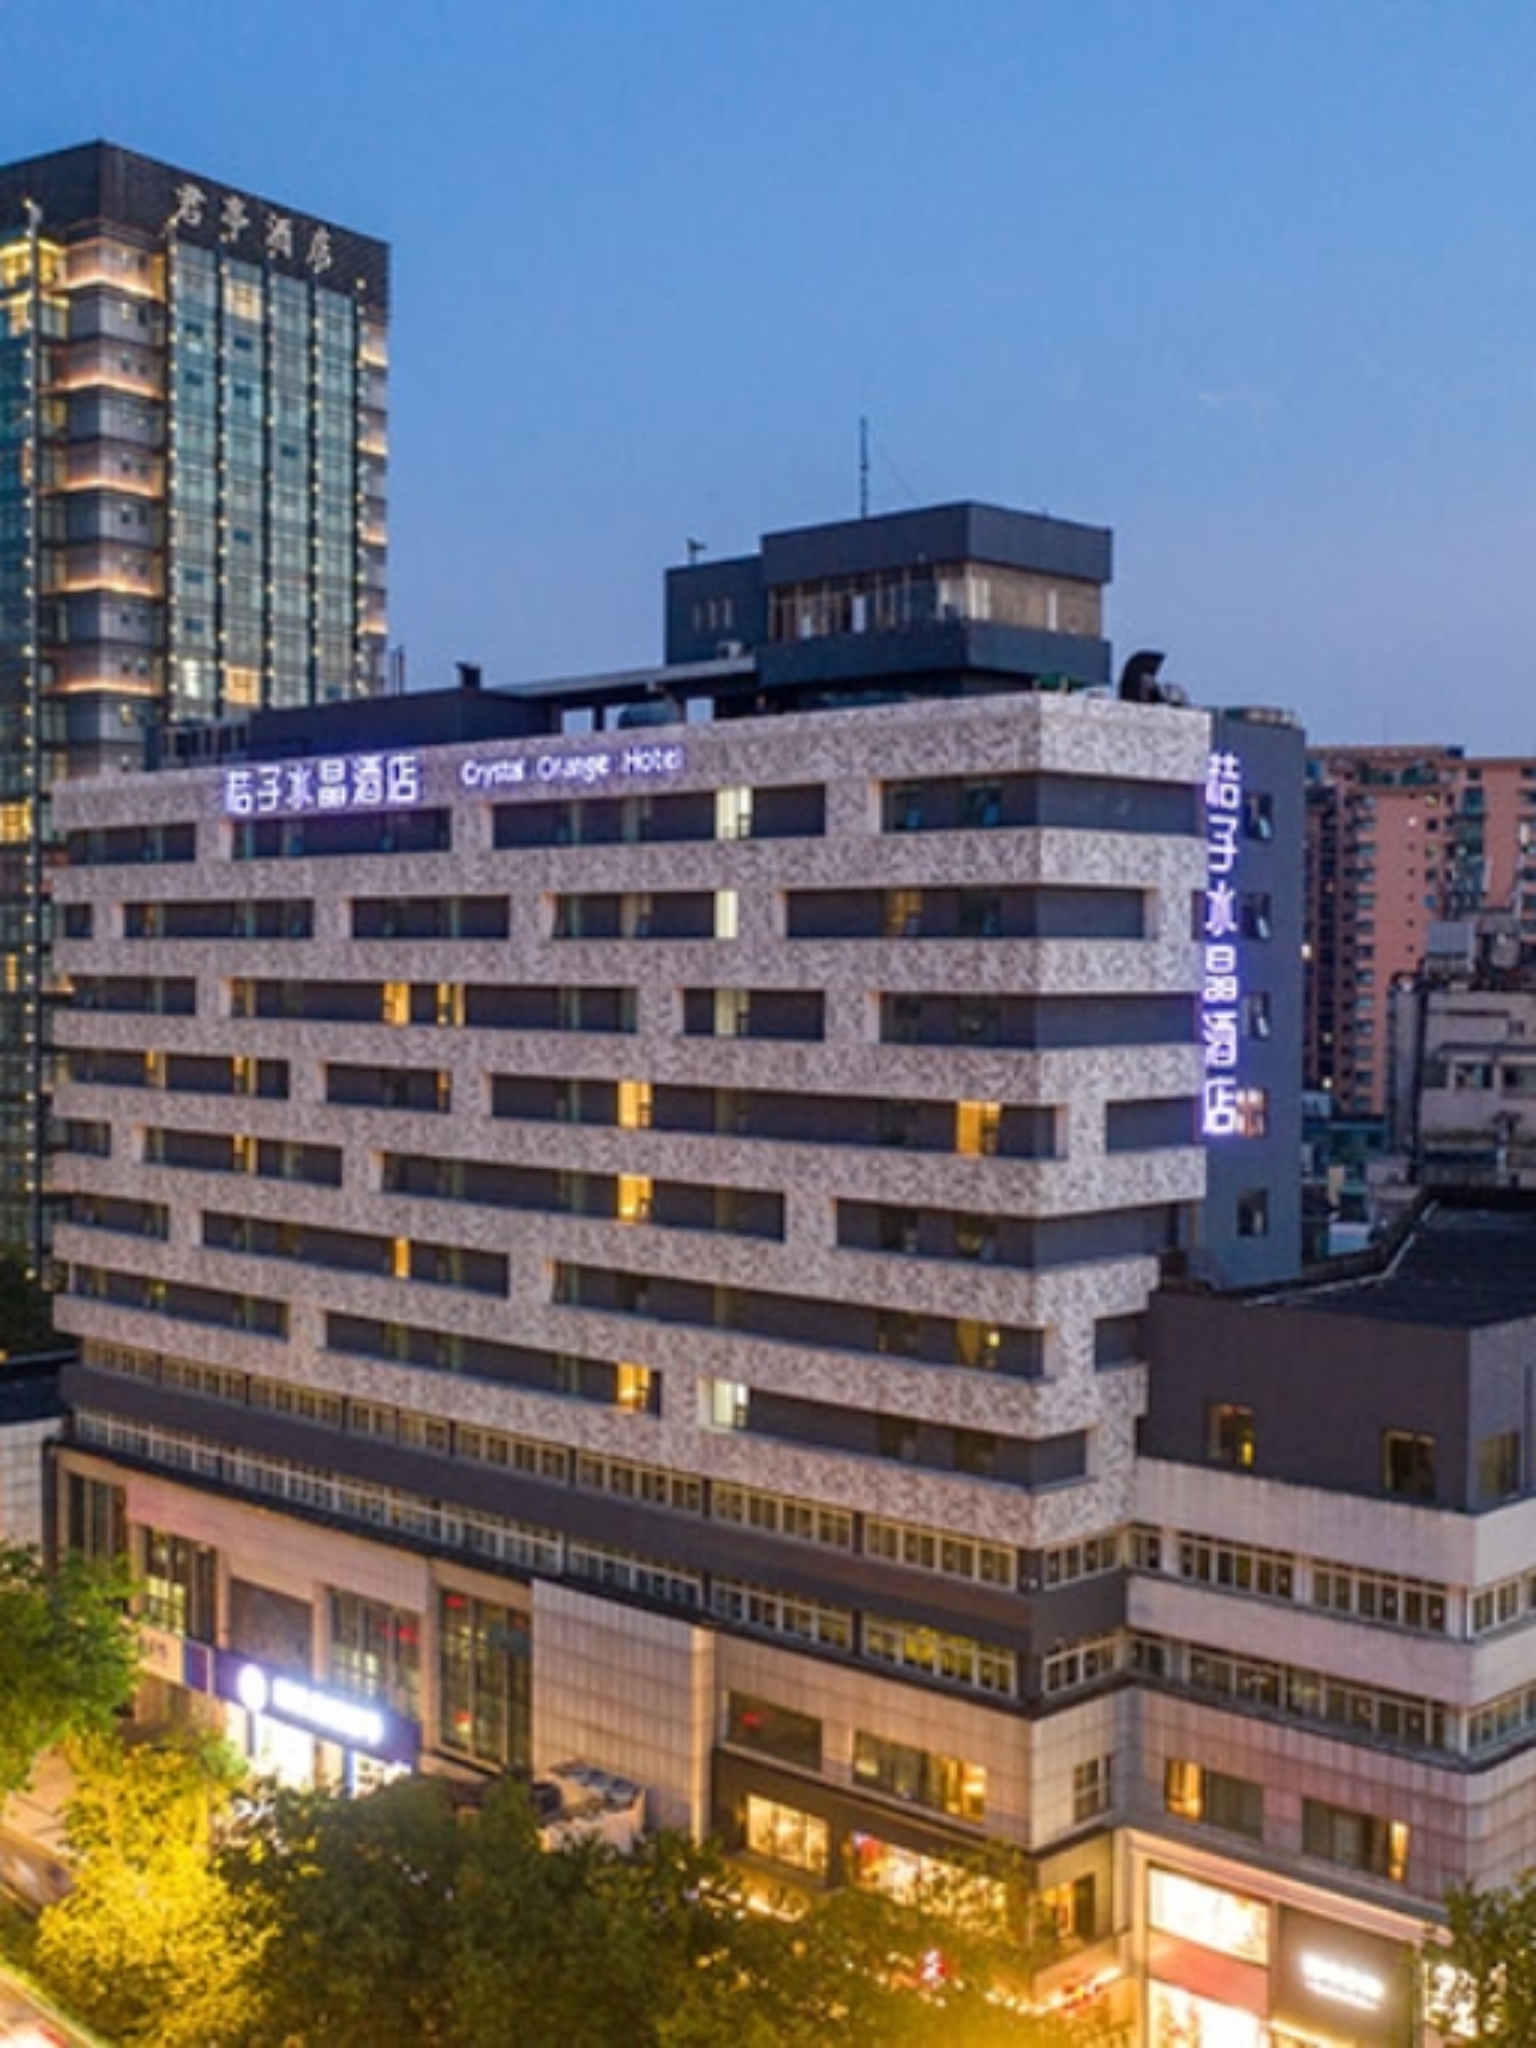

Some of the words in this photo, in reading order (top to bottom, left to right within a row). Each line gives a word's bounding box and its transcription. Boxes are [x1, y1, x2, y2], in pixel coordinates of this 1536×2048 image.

[173, 182, 332, 274] 君亭酒店
[226, 754, 419, 815] 桔子水晶酒店
[623, 746, 682, 774] Hotel
[1202, 751, 1241, 1136] 桔子水晶酒店
